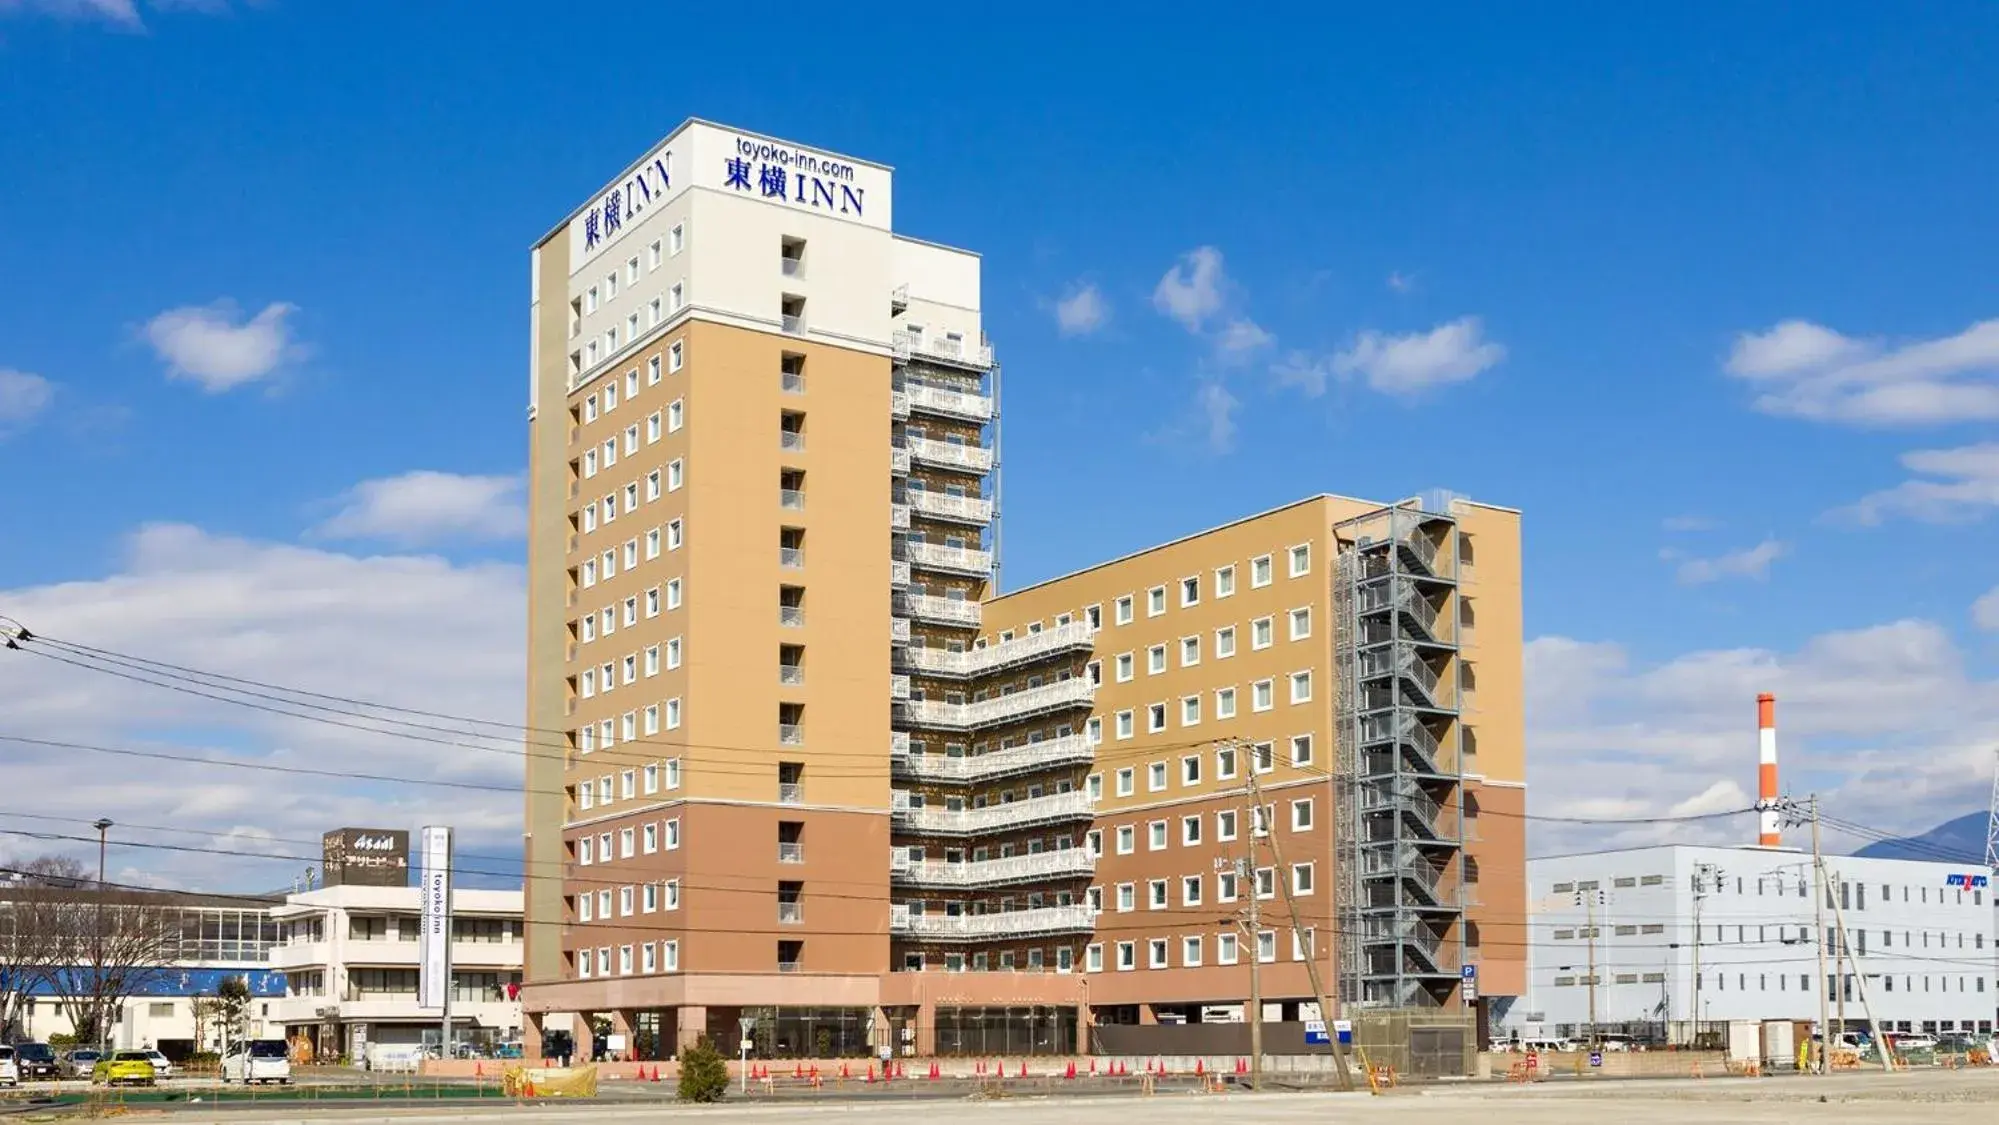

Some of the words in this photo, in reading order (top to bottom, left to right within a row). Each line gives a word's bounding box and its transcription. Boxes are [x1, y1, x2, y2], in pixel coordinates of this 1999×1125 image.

[724, 156, 865, 217] 東横INN
[736, 136, 855, 181] toyoko-inn.com
[584, 150, 673, 253] 東横INN
